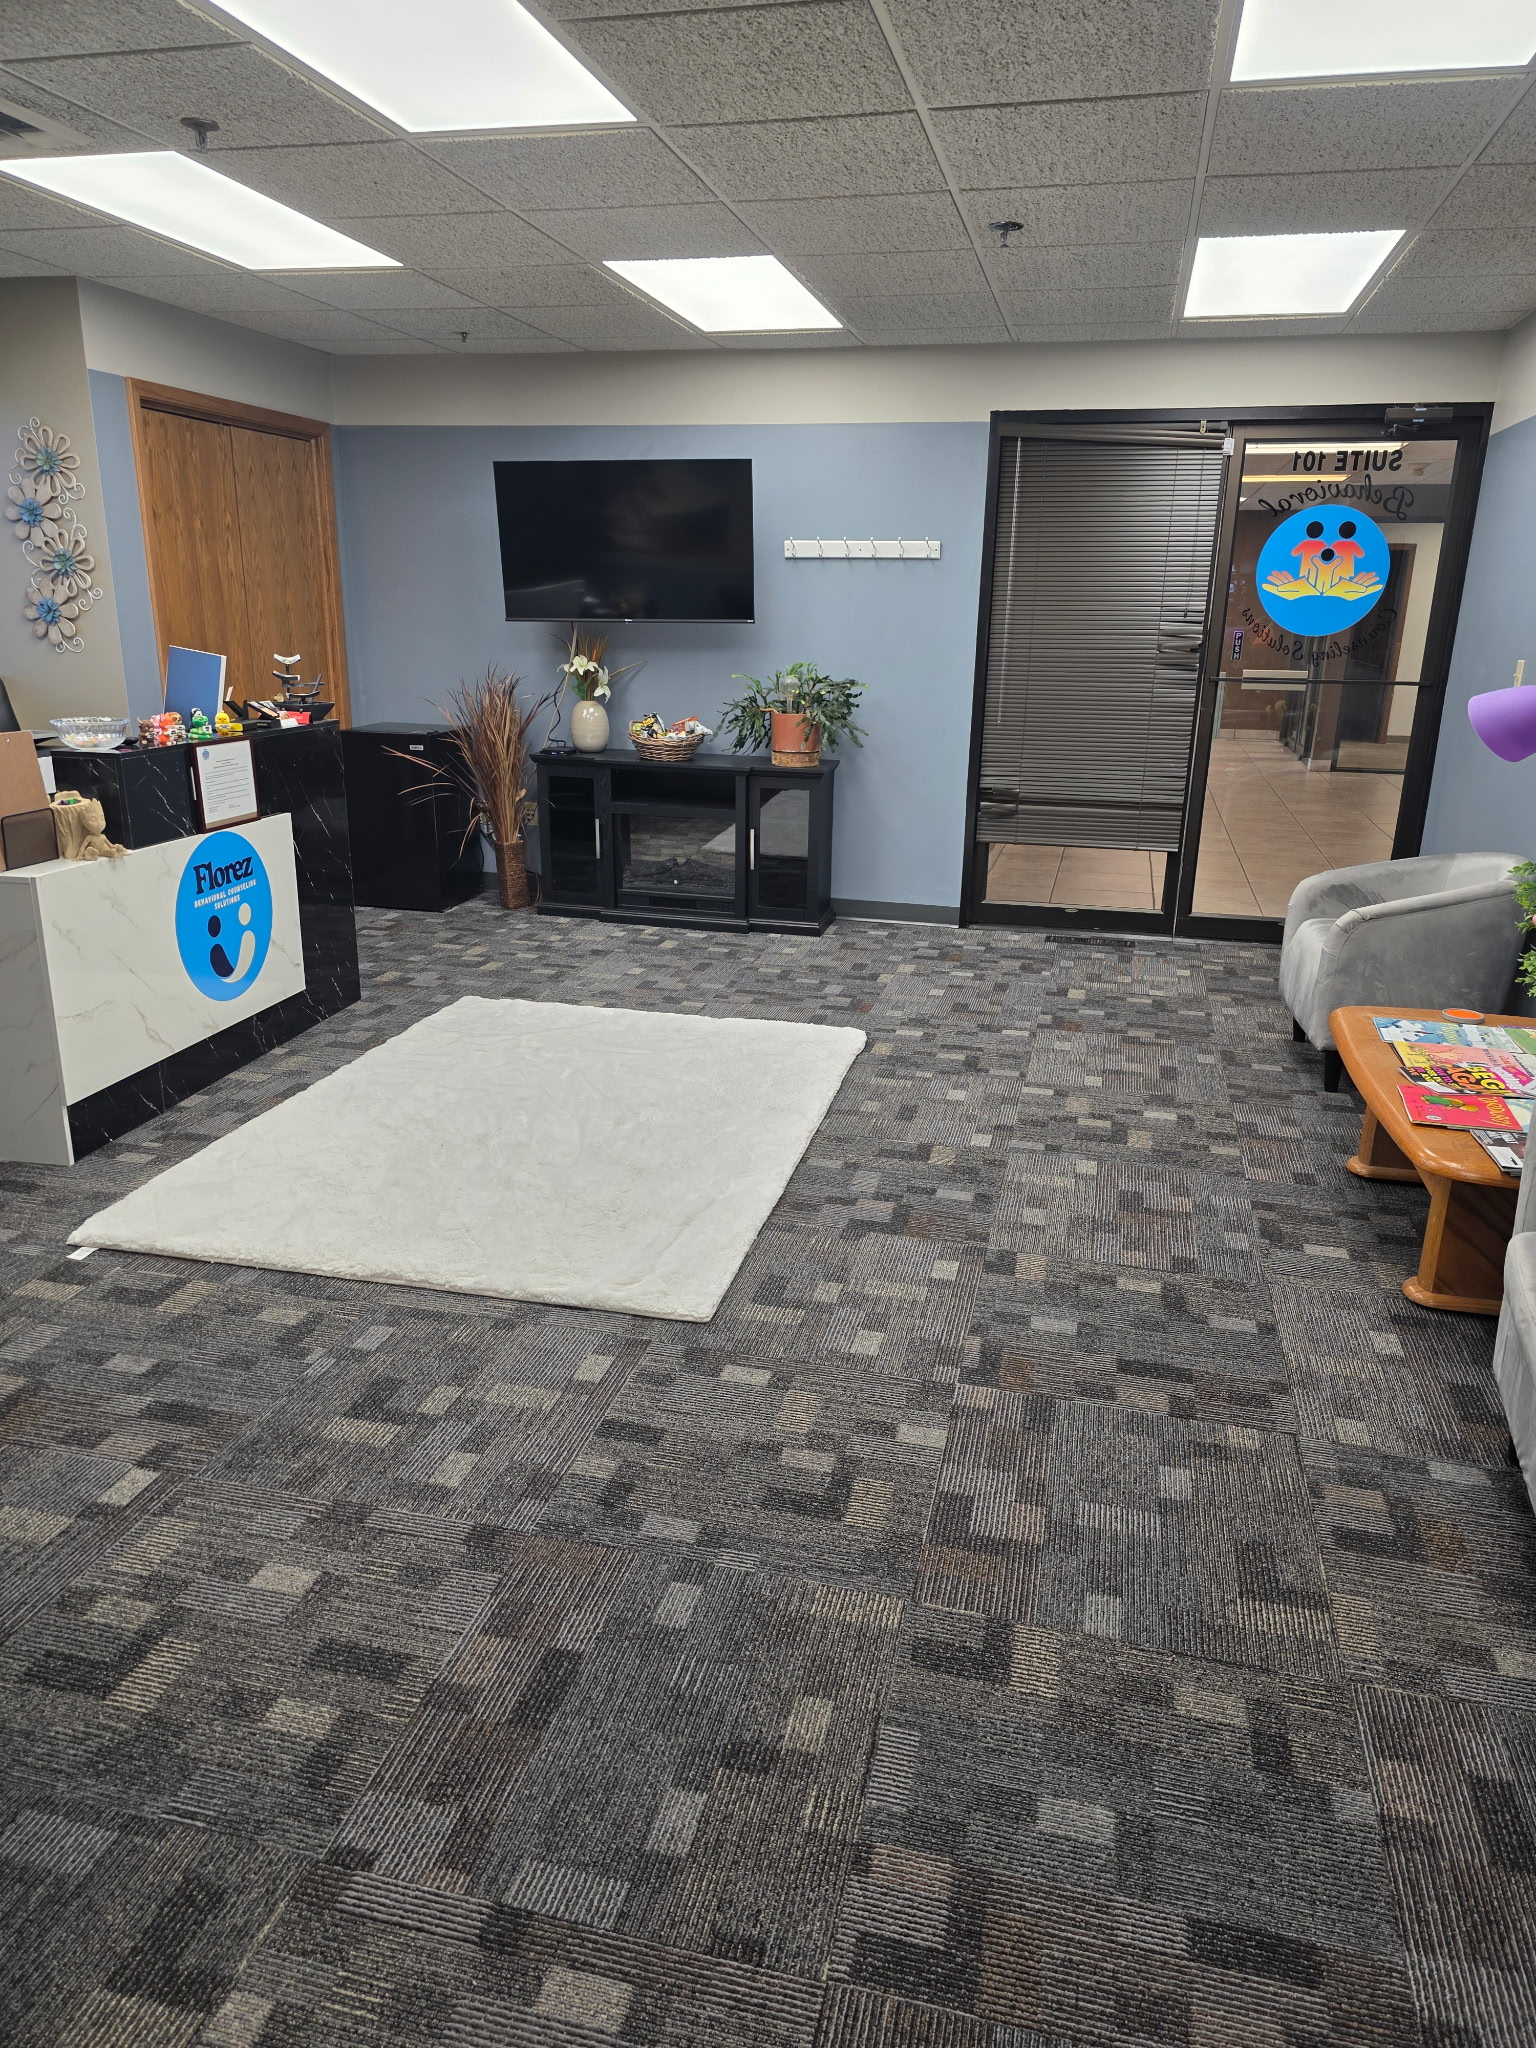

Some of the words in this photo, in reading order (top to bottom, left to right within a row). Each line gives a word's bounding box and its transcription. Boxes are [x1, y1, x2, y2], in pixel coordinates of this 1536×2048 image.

[1232, 631, 1243, 660] PUSH
[192, 856, 254, 895] Florez
[193, 890, 227, 909] BEHAVIORAL
[227, 878, 257, 896] COUNSELING
[213, 893, 241, 910] SOLUTIONS
